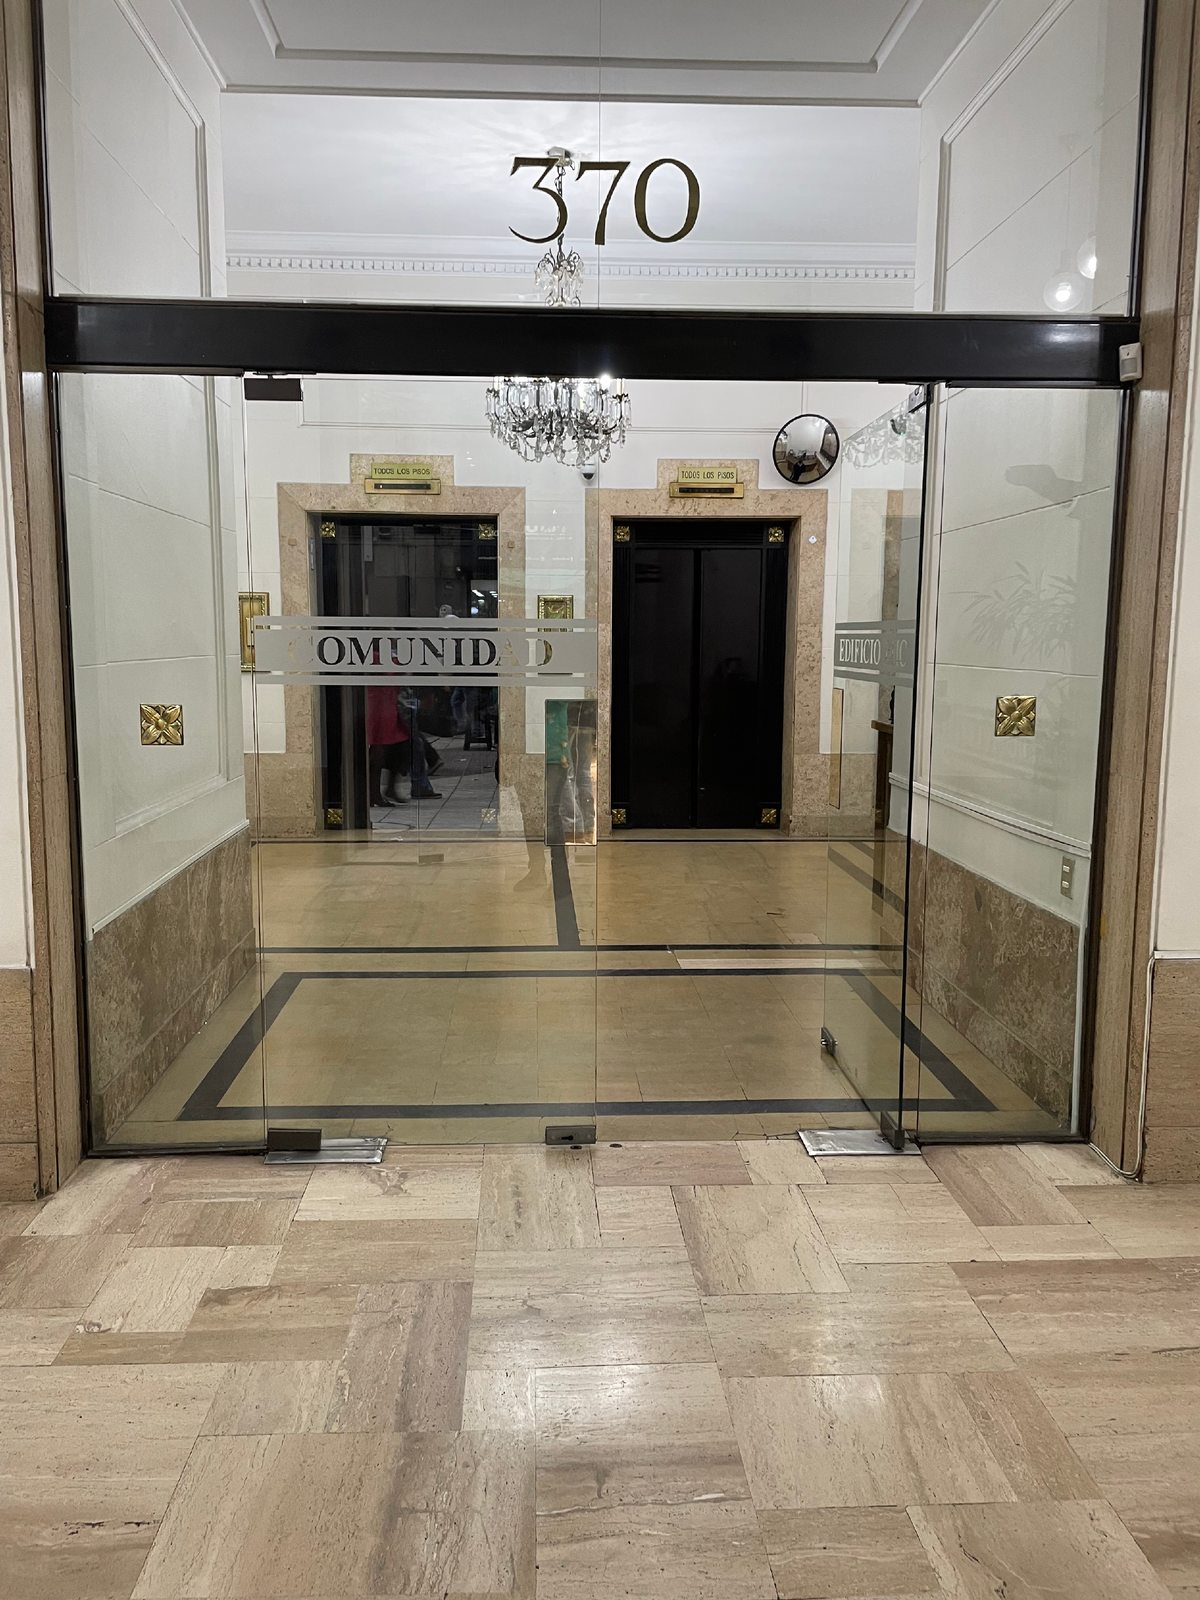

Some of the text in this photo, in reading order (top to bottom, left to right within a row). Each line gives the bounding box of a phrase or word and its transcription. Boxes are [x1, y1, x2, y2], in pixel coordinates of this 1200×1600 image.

[509, 157, 701, 245] 370
[681, 470, 700, 479] TODOS
[702, 471, 715, 479] LOS
[839, 638, 881, 665] EDIFICIO
